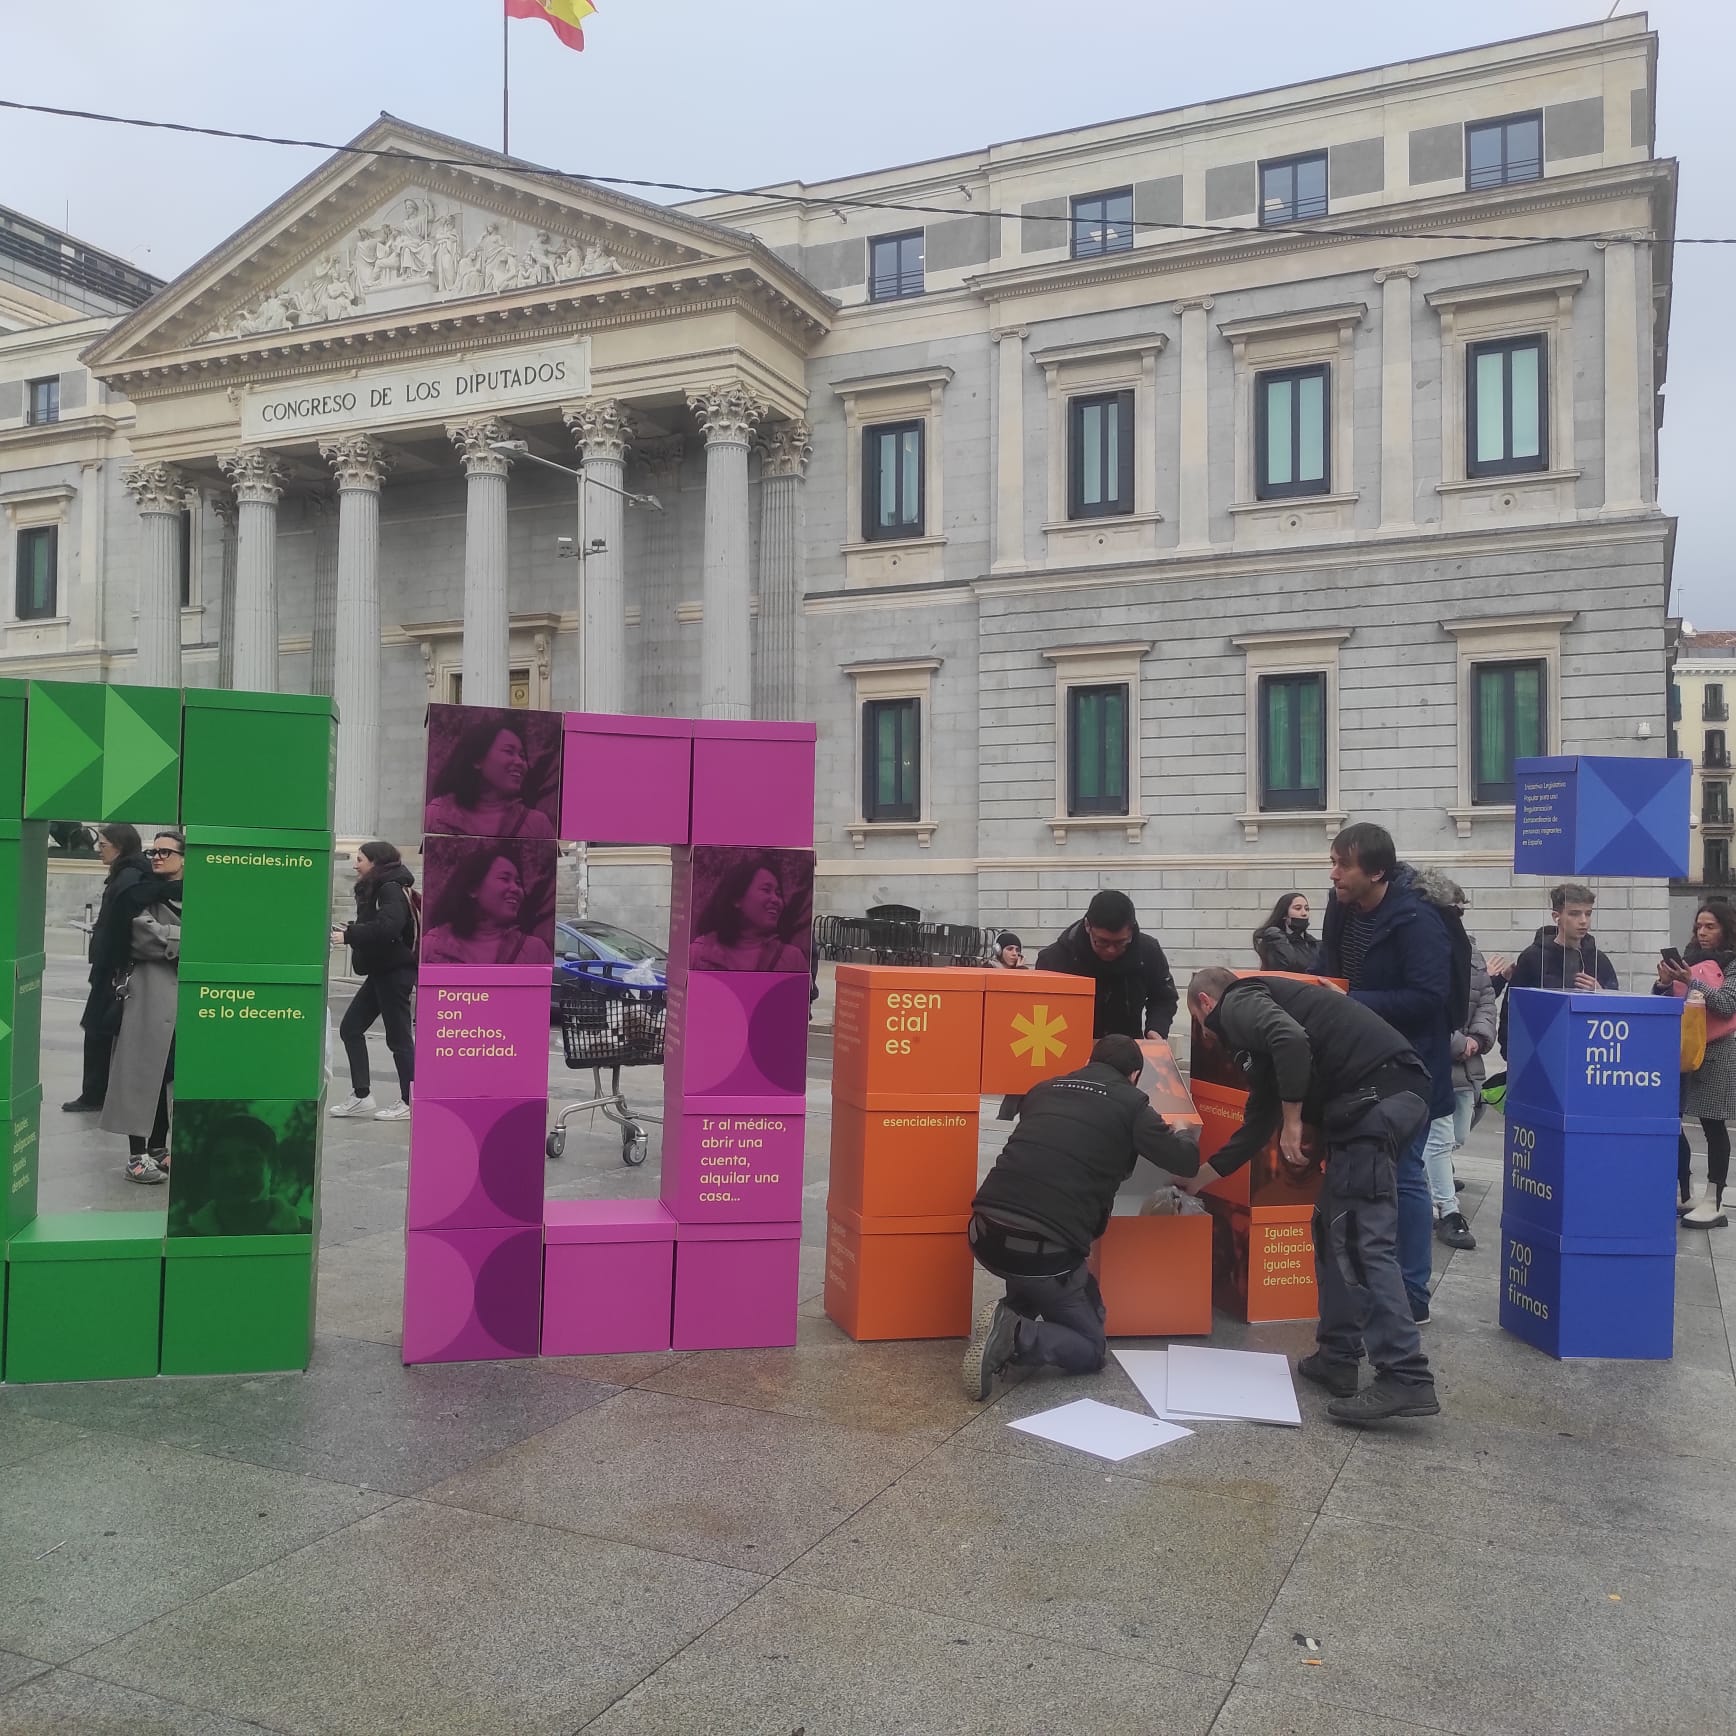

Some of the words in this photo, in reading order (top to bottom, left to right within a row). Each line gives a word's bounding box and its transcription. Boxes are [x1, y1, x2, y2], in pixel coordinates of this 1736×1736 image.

[262, 393, 357, 422] CONGRESO
[370, 387, 392, 407] DE
[406, 381, 441, 401] LOS
[456, 361, 566, 395] DIPUTADOS
[206, 853, 313, 869] esenciales.info
[200, 987, 256, 1002] Porque
[438, 989, 489, 1005] Porque
[887, 993, 942, 1009] esen
[198, 1008, 216, 1019] es
[221, 1005, 235, 1019] lo
[239, 1006, 305, 1019] decente.
[437, 1010, 462, 1020] son
[886, 1010, 928, 1032] cial
[436, 1026, 506, 1041] derechos,
[1586, 1020, 1629, 1040] 700
[435, 1047, 454, 1057] no
[458, 1043, 517, 1057] caridad.
[885, 1038, 911, 1055] es
[1586, 1042, 1621, 1063] mil
[1585, 1064, 1661, 1087] firmas
[702, 1119, 715, 1131] Ir
[718, 1118, 731, 1130] al
[734, 1118, 787, 1133] médico,
[883, 1115, 967, 1127] esenciales.info
[701, 1136, 735, 1148] abrir
[738, 1138, 763, 1148] una
[1512, 1125, 1535, 1149] 700
[700, 1155, 751, 1168] cuenta,
[1512, 1149, 1531, 1171] mil
[700, 1171, 751, 1187] alquilar
[754, 1173, 779, 1183] una
[1511, 1168, 1553, 1200] firmas
[699, 1192, 740, 1202] casa...
[1264, 1226, 1304, 1240] Iguales
[1510, 1239, 1532, 1266] 700
[1263, 1258, 1302, 1273] iguales
[1263, 1274, 1313, 1286] derechos.
[1509, 1264, 1527, 1287] mil
[1508, 1283, 1549, 1320] firmas
